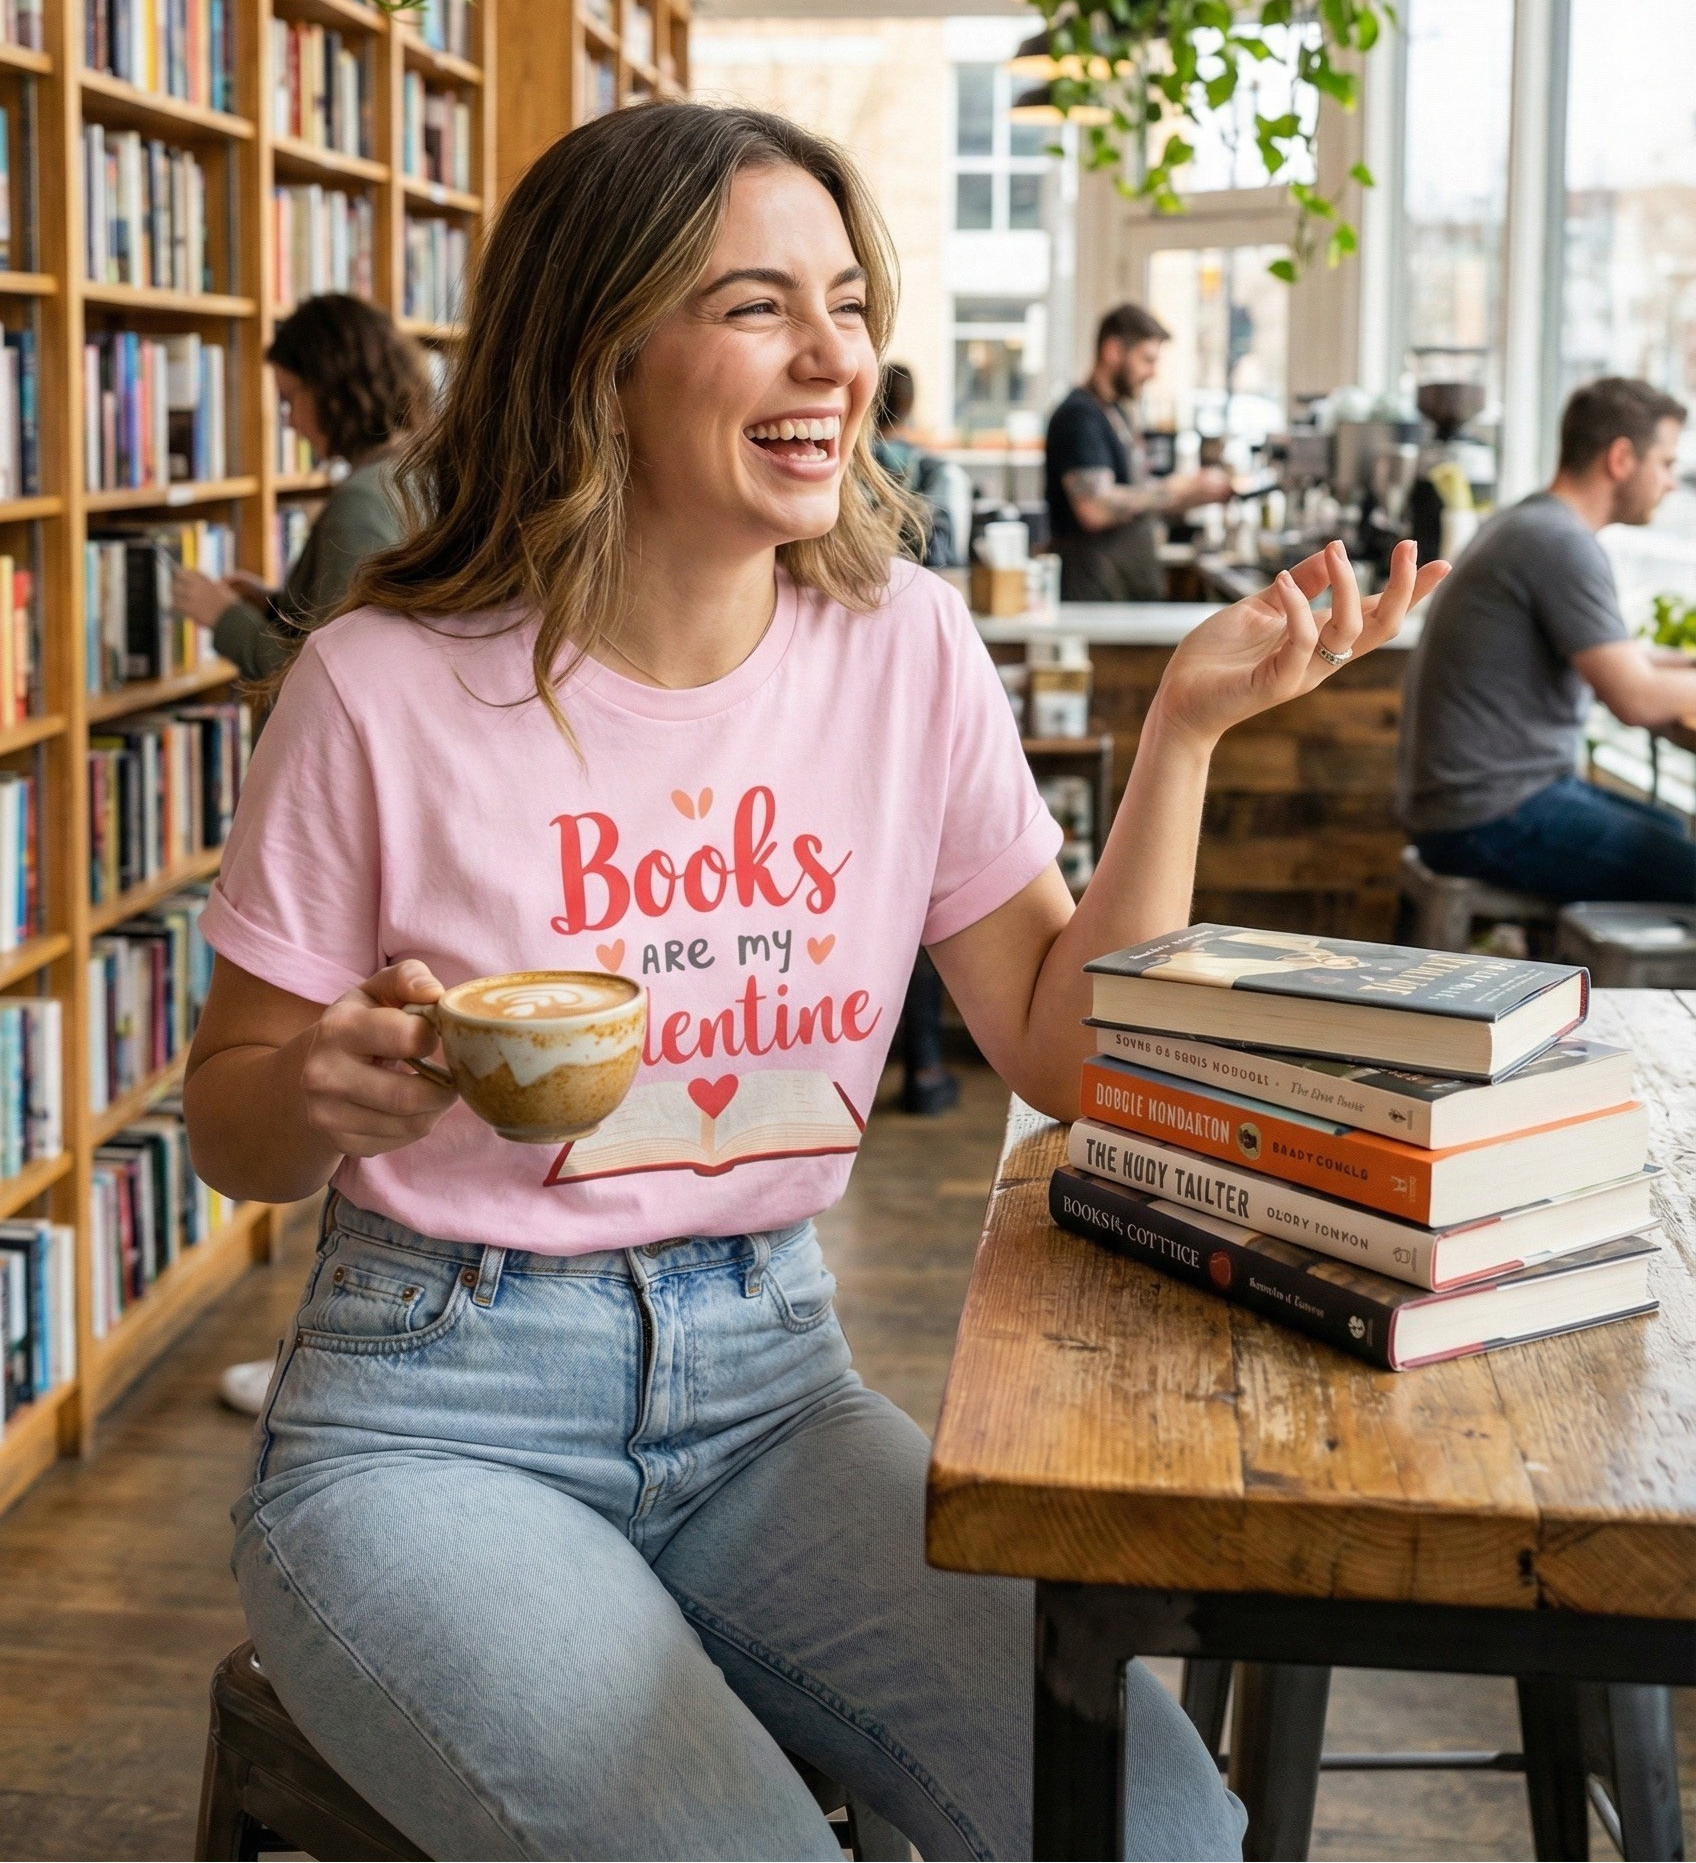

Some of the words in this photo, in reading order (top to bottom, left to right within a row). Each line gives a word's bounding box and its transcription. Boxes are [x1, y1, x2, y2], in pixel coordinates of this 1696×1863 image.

[549, 785, 853, 936] Books
[738, 929, 792, 974] my
[1086, 1138, 1118, 1174] THE
[1175, 1167, 1250, 1219] TAILTER
